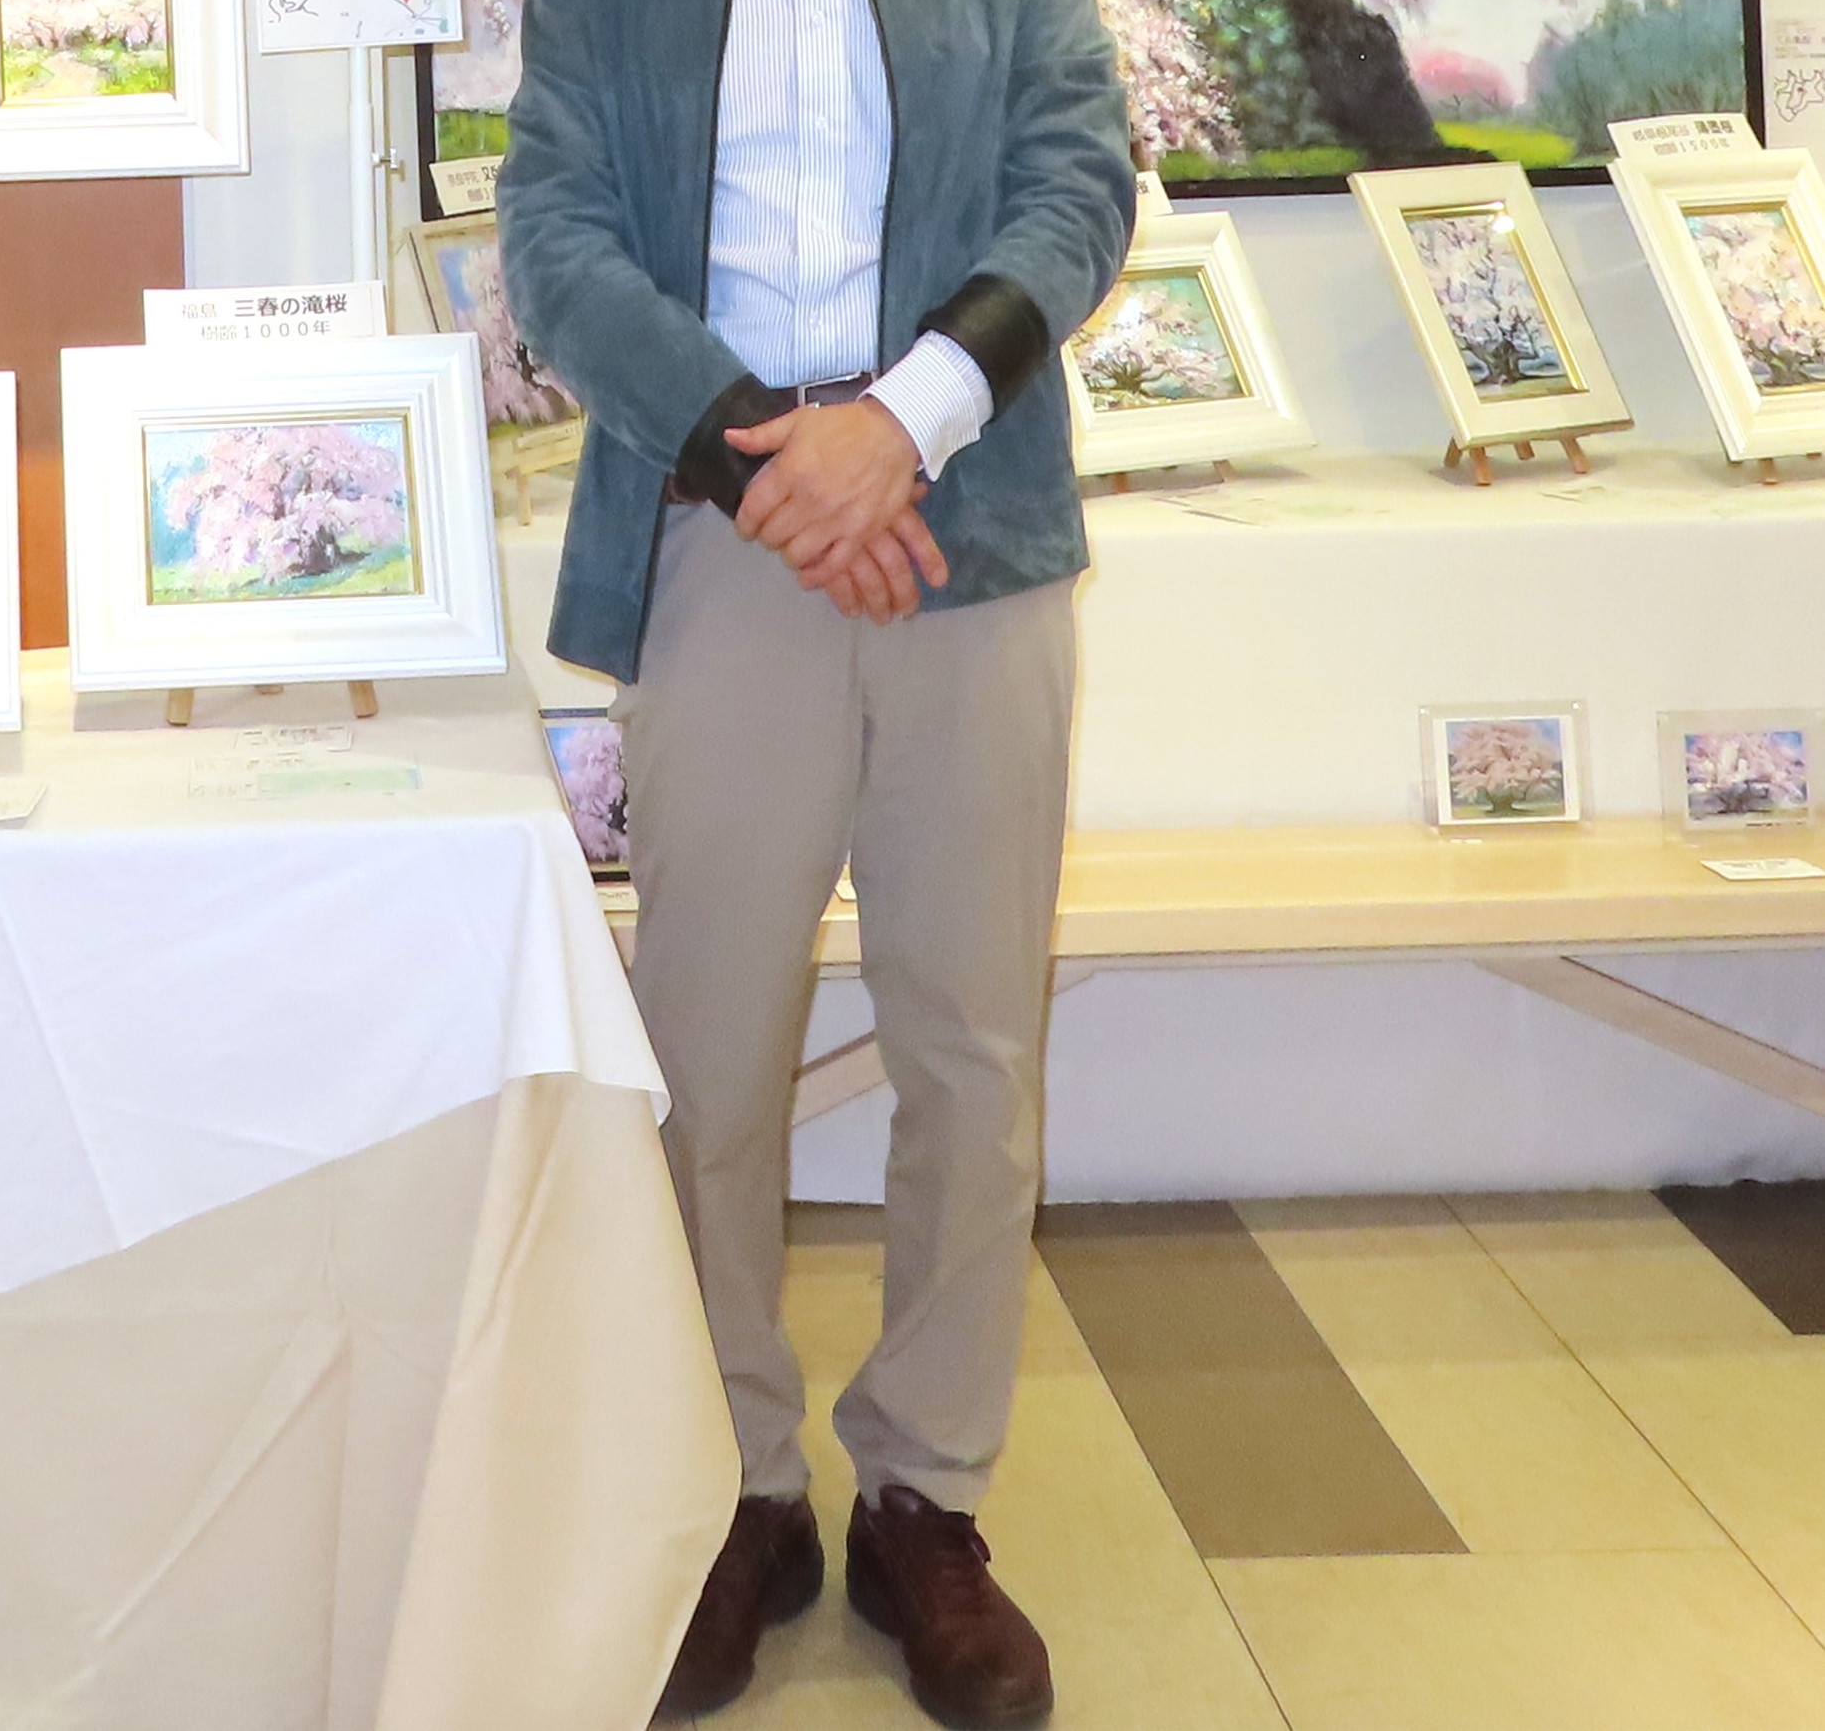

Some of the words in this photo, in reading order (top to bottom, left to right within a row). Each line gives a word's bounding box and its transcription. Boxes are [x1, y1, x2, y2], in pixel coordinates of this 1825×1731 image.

[234, 293, 348, 318] 三春の滝桜
